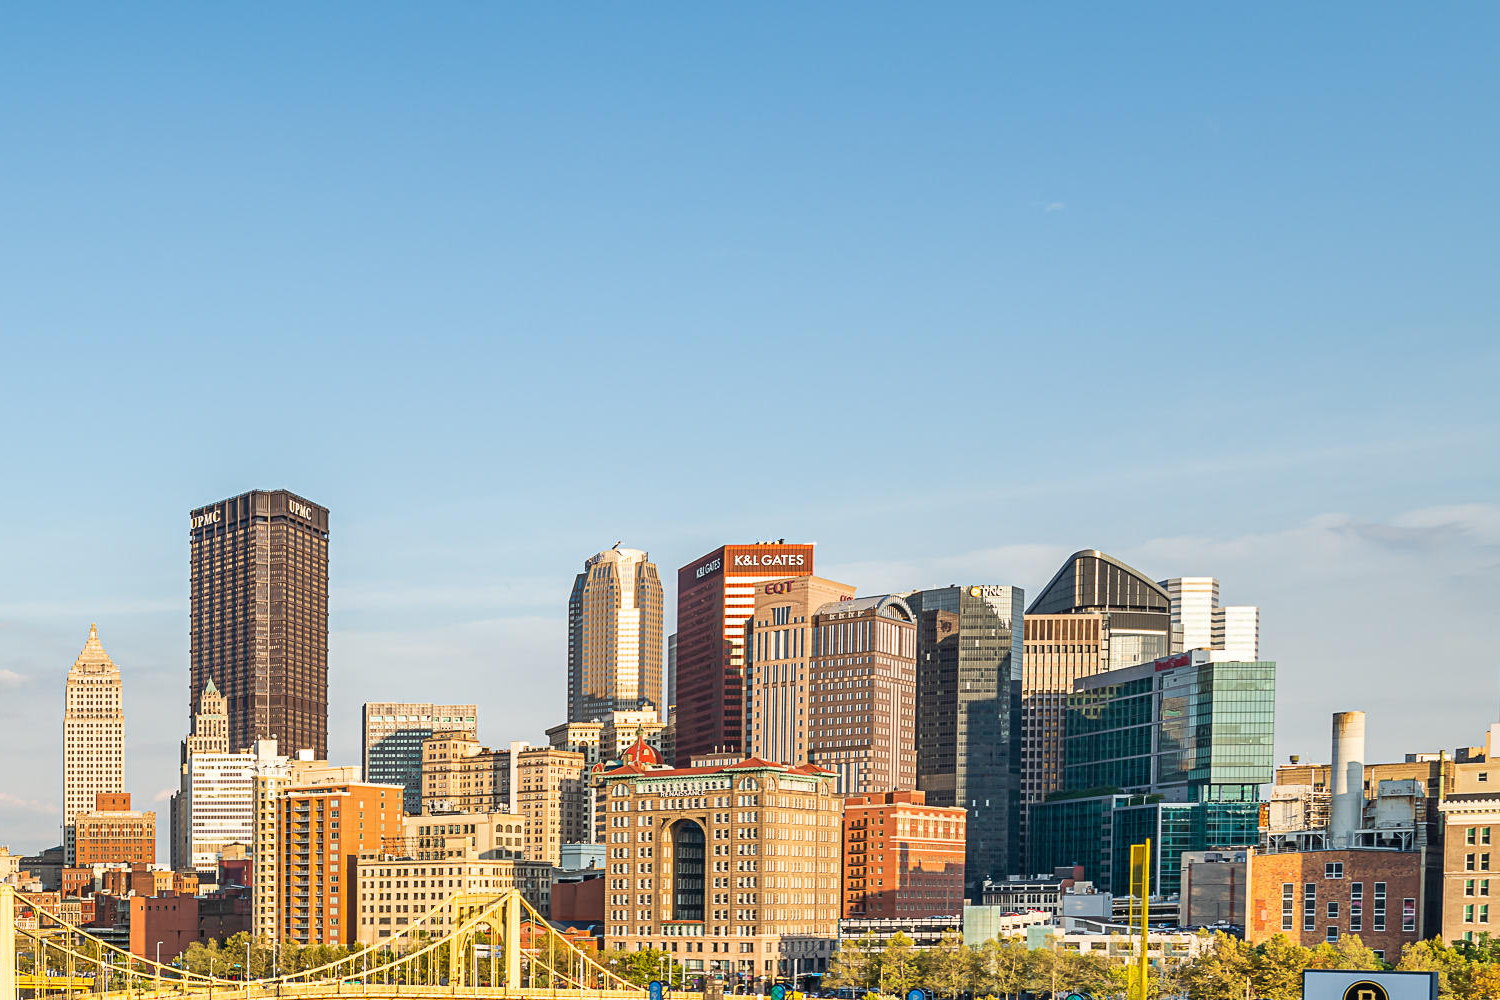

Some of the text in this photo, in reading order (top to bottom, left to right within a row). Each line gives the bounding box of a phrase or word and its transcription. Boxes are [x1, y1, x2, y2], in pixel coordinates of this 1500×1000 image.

[289, 500, 311, 520] UPMC
[191, 510, 220, 529] UPMC
[705, 558, 721, 574] GATES
[734, 554, 804, 566] K&L GATES
[765, 580, 795, 595] EQT
